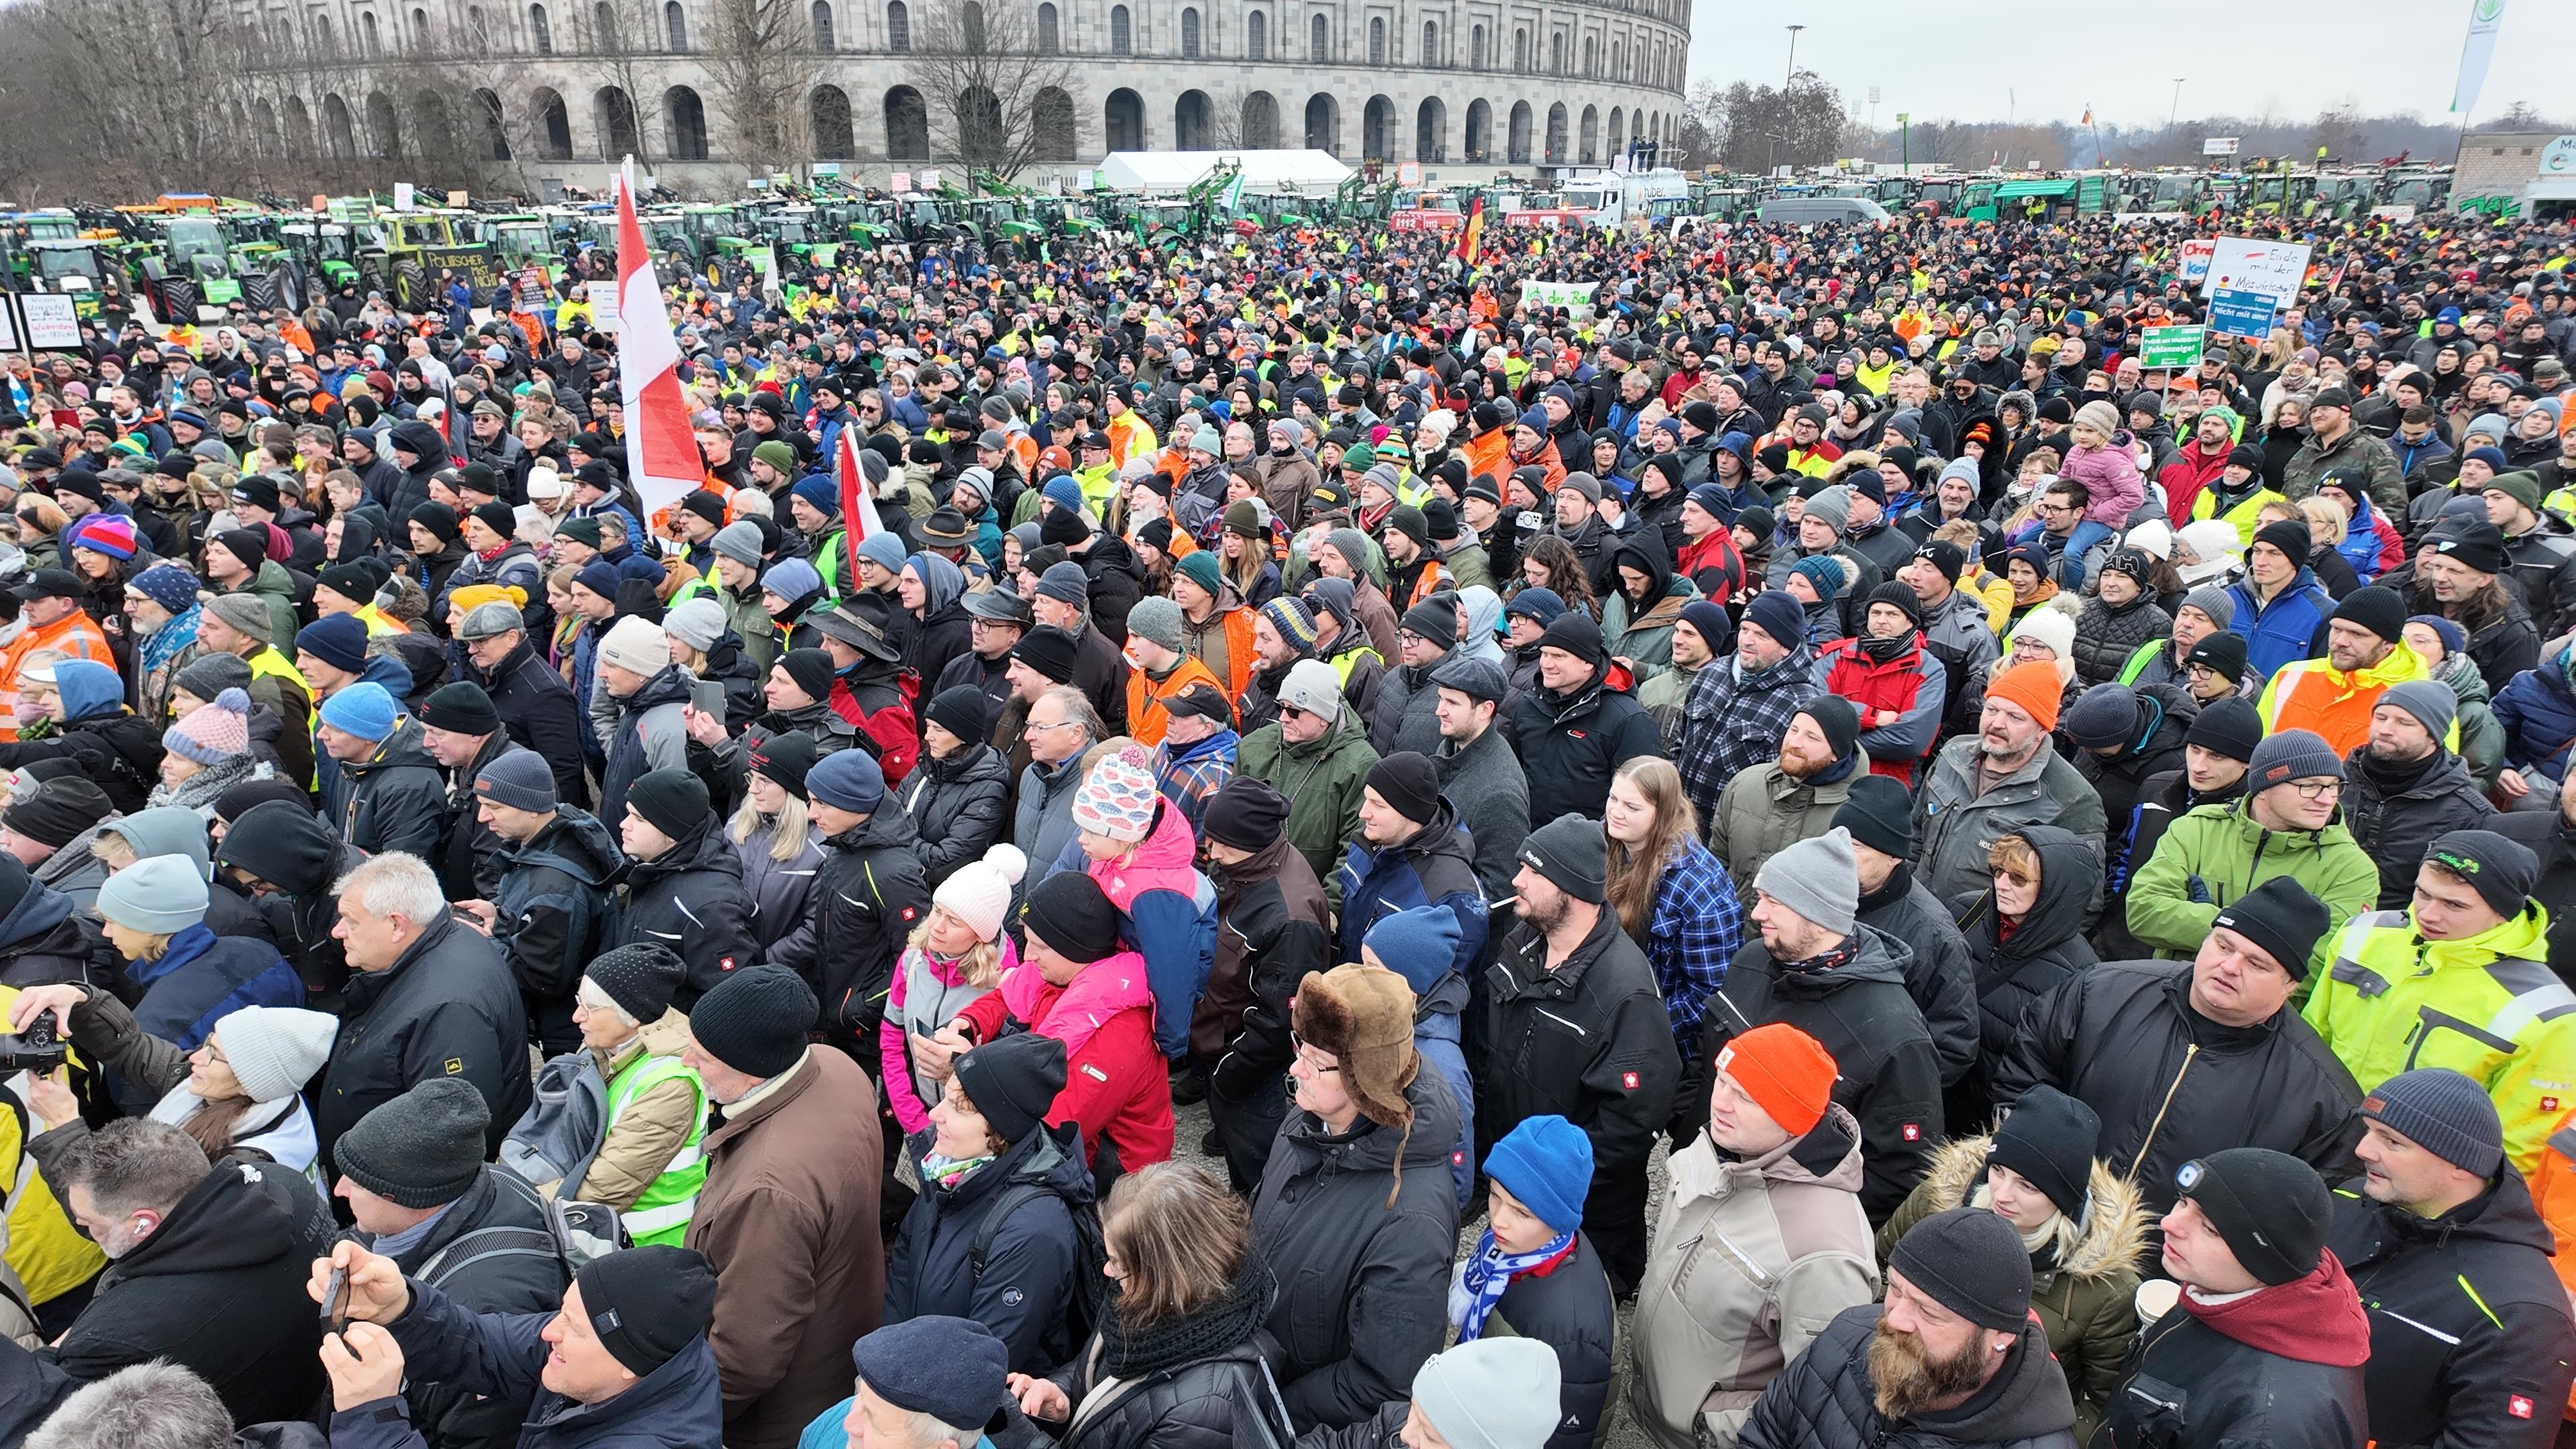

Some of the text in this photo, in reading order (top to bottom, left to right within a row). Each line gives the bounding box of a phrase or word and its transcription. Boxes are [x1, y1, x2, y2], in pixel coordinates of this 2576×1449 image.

[1400, 218, 1416, 228] 112
[1428, 219, 1438, 228] 112
[1515, 216, 1530, 225] 112
[2269, 248, 2298, 263] Ende
[471, 265, 489, 276] MIST
[474, 273, 498, 288] NICHT
[1548, 290, 1565, 304] der
[2214, 307, 2235, 316] Nicht
[2251, 313, 2269, 321] uns!
[2148, 344, 2196, 354] Fehlanzeige!
